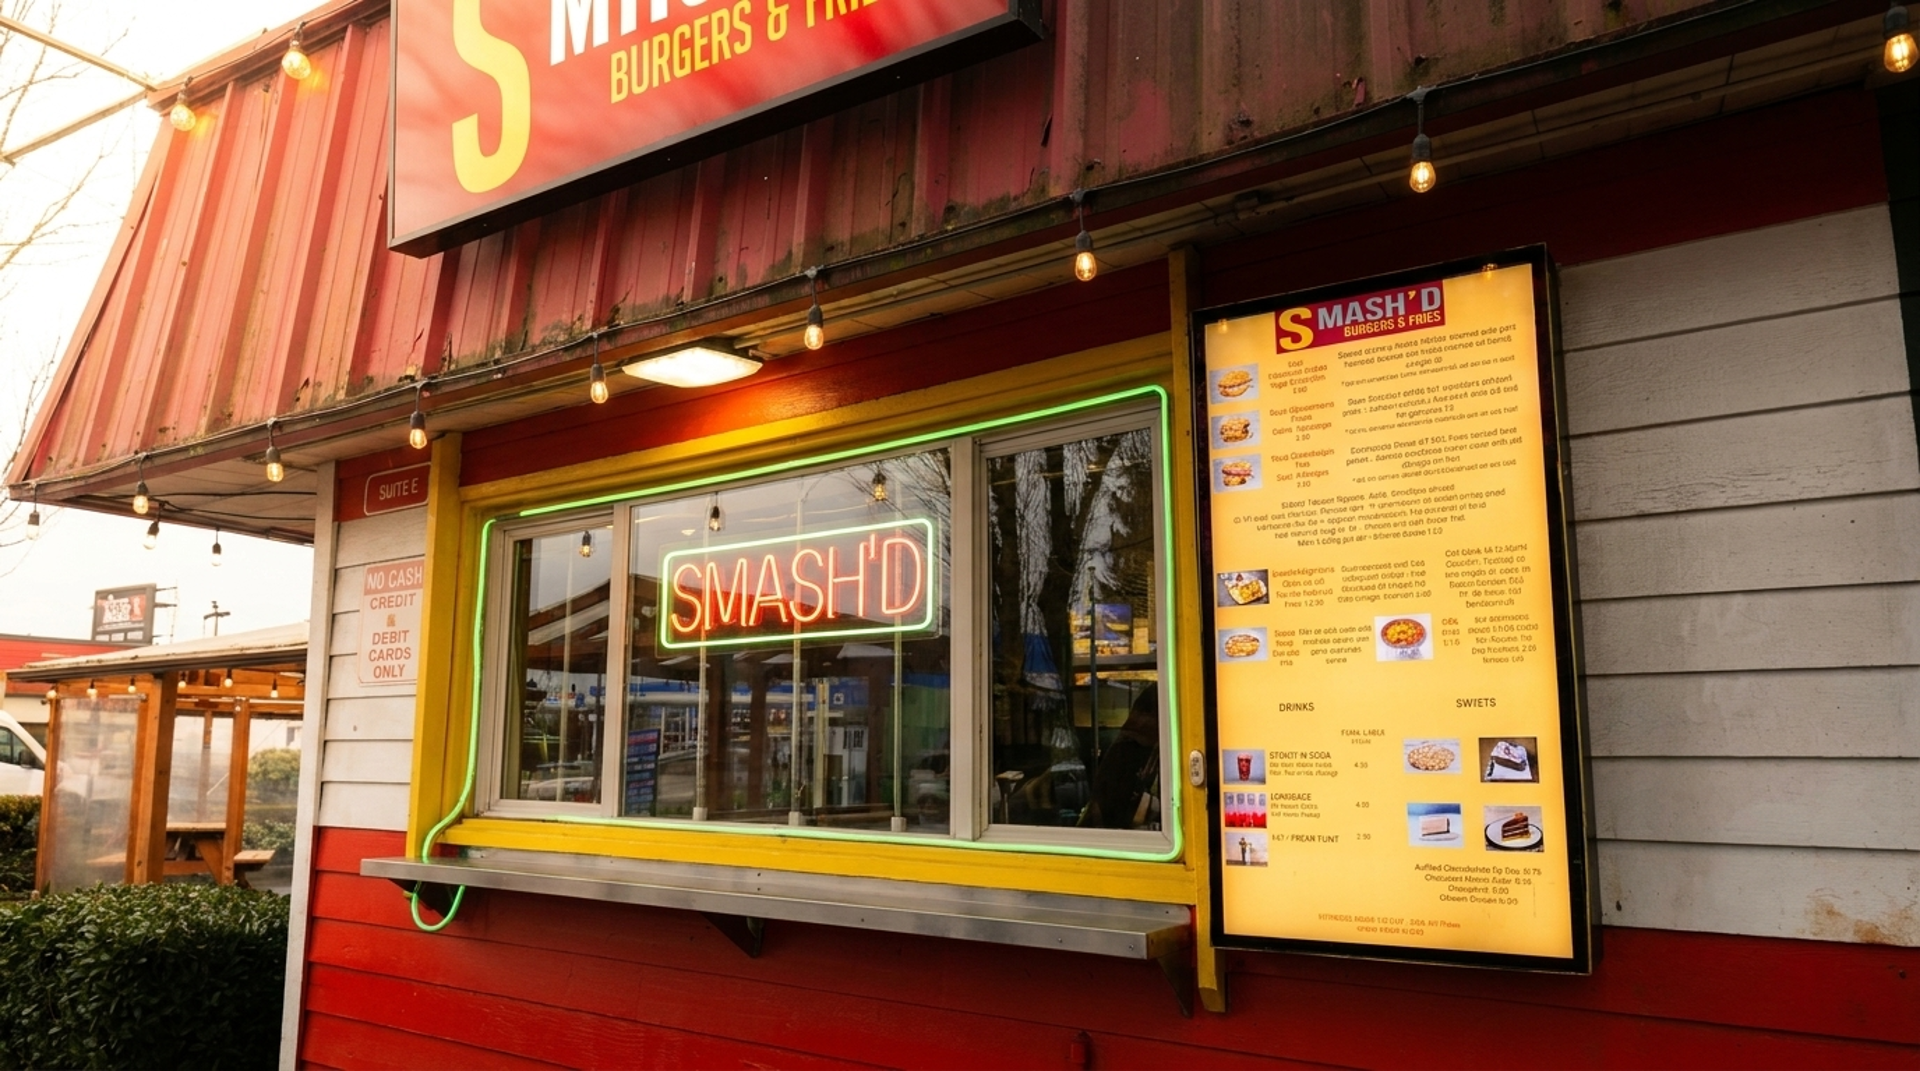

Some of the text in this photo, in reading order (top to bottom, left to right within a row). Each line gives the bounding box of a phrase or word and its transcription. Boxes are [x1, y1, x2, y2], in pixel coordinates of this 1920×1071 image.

[610, 0, 789, 104] BURGERS &
[1408, 310, 1441, 326] FRIES
[379, 477, 419, 500] SUITE E
[367, 565, 423, 590] NO CASH
[671, 533, 922, 633] SMASH'D
[370, 593, 417, 610] CREDIT
[372, 629, 410, 646] DEBIT
[368, 646, 412, 662] CARDS
[373, 664, 406, 679] ONLY
[1279, 702, 1315, 713] DRINKS
